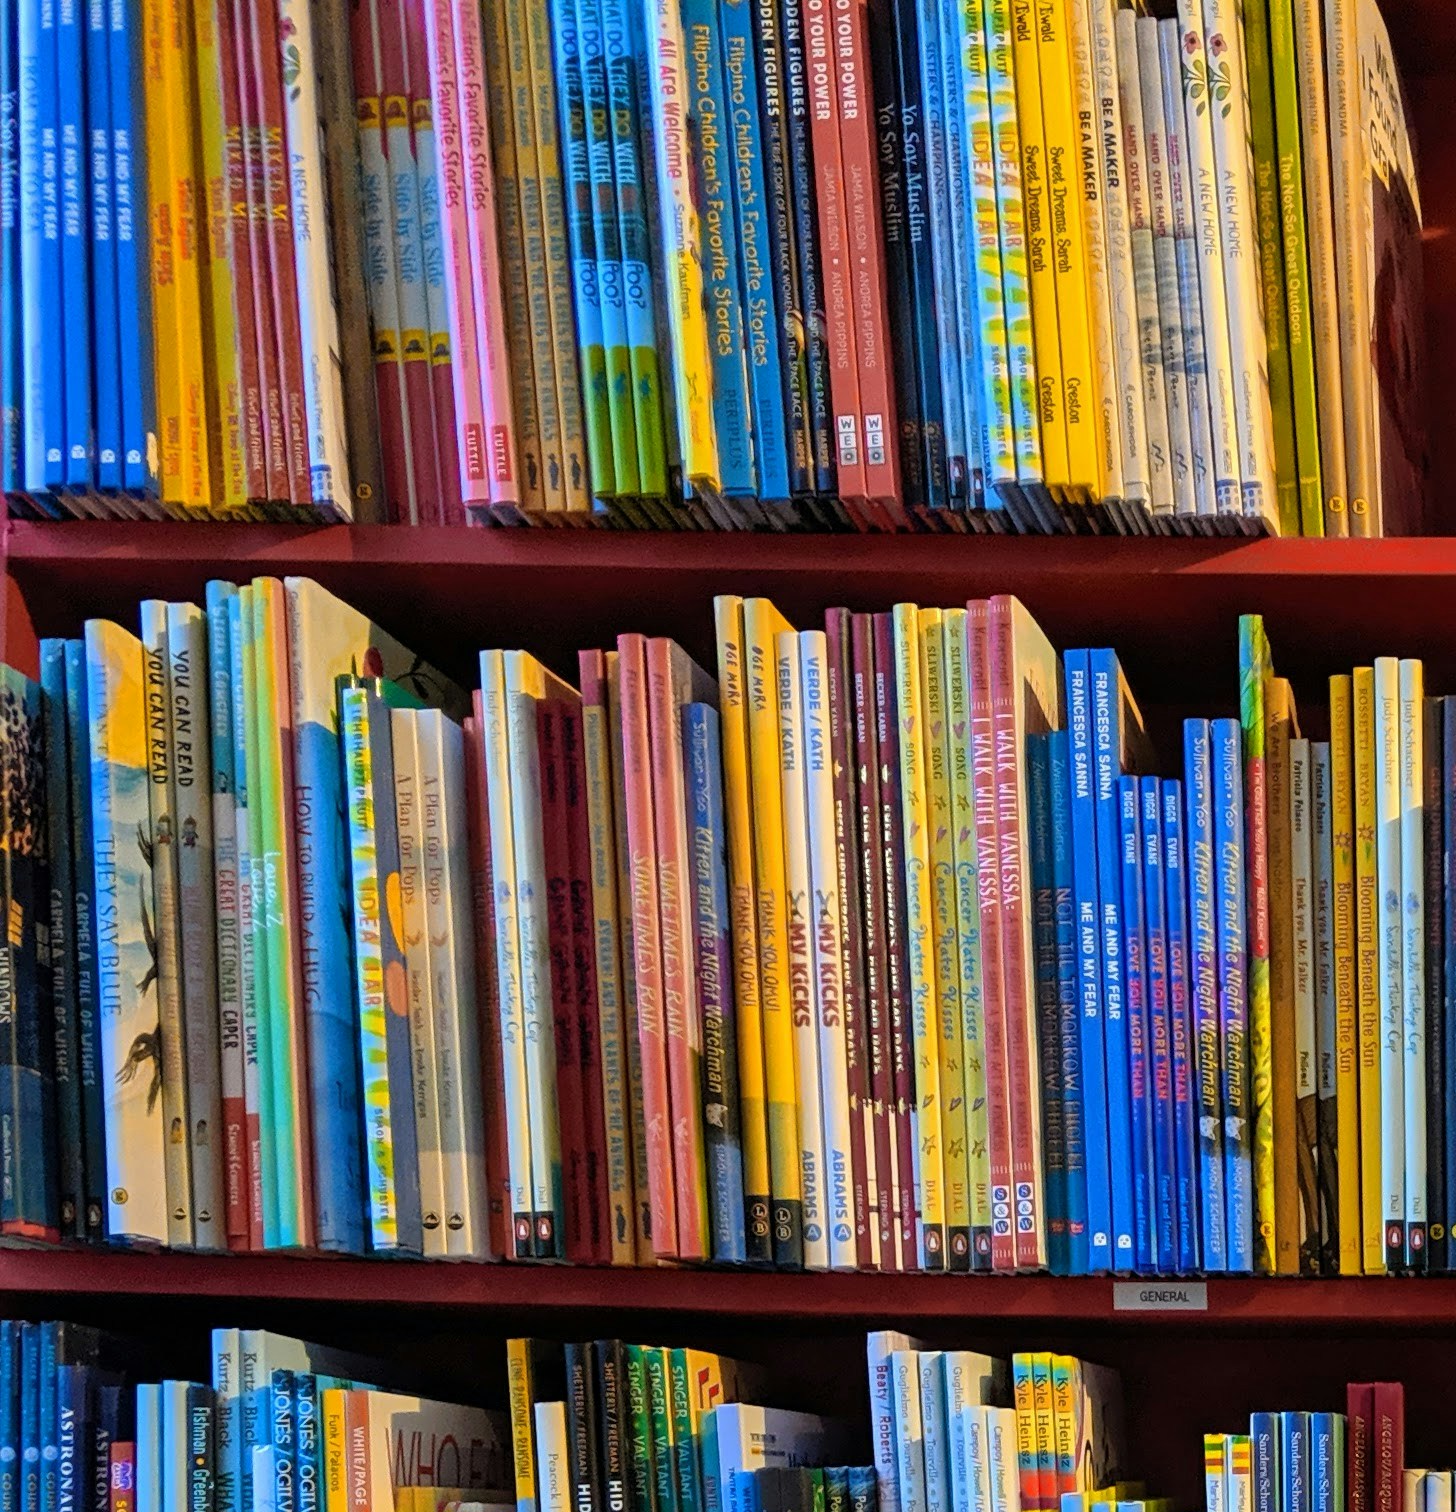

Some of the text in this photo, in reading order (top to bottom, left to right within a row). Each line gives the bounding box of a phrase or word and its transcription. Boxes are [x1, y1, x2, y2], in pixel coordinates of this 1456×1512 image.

[727, 37, 770, 367] Filipino Children's Favorite Stories
[898, 104, 924, 243] Yo Soy Muslim
[1050, 146, 1072, 273] Sweet Dreams, Sarah
[1281, 154, 1302, 344] The Not-So Great Outdoors
[146, 648, 169, 785] YOU CAN READ
[806, 656, 825, 771] VERDE KATH
[995, 729, 1016, 781] WALK
[1094, 671, 1113, 800] FRANCESCA SANNA
[996, 787, 1018, 826] WITH
[95, 835, 122, 1017] THEY SAY BLUE
[998, 831, 1020, 910] VANESSA:
[818, 923, 838, 955] MY
[1080, 902, 1098, 1017] ME AND MY FEAR
[830, 1149, 847, 1220] ABRAMS
[1140, 1291, 1189, 1302] GENERAL
[353, 1426, 368, 1506] WHITE/PAGE
